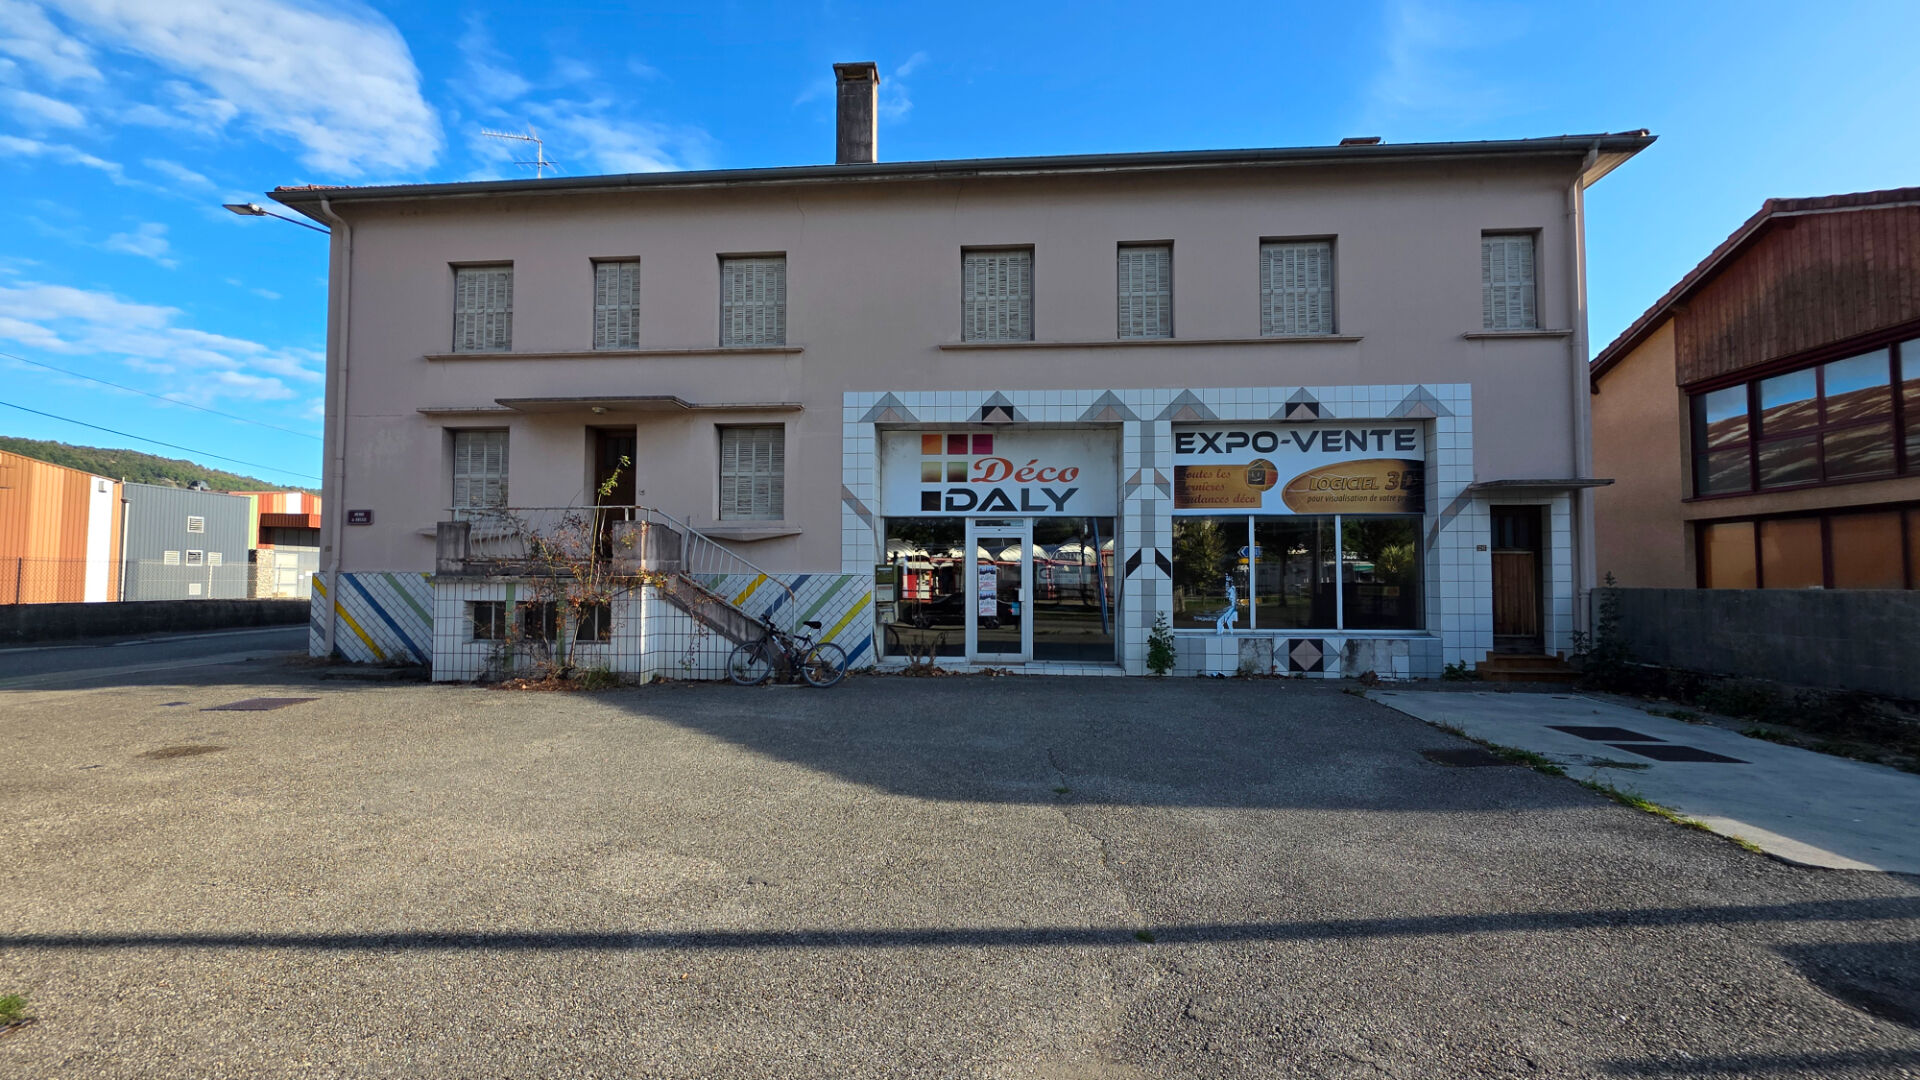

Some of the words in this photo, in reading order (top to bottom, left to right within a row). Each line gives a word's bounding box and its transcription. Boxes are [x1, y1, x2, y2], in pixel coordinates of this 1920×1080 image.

[1175, 428, 1416, 455] EXPO-VENTE
[970, 457, 1080, 483] Déco
[1308, 477, 1380, 491] LOGICIEL
[945, 487, 1080, 512] DALY
